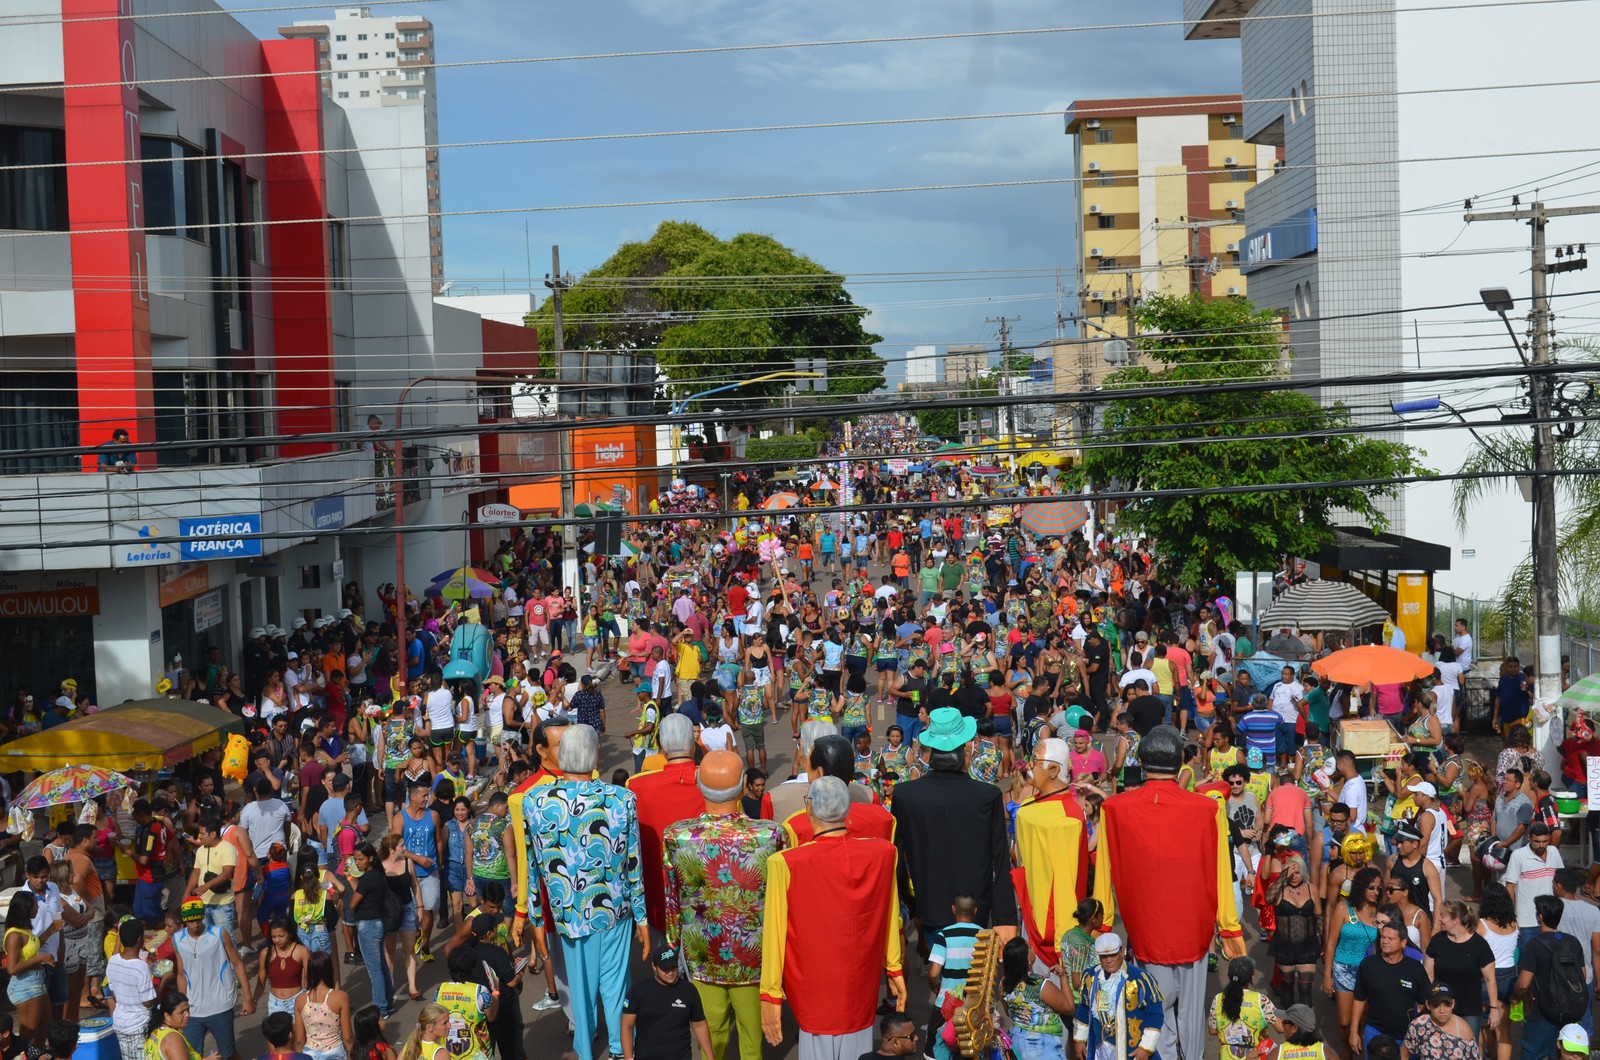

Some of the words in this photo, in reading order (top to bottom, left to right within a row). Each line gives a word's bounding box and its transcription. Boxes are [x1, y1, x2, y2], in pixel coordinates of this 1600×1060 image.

[482, 506, 516, 517] Colortec
[189, 521, 251, 537] LOTÉRICA
[190, 539, 244, 552] FRANÇA
[127, 551, 171, 561] Loterias
